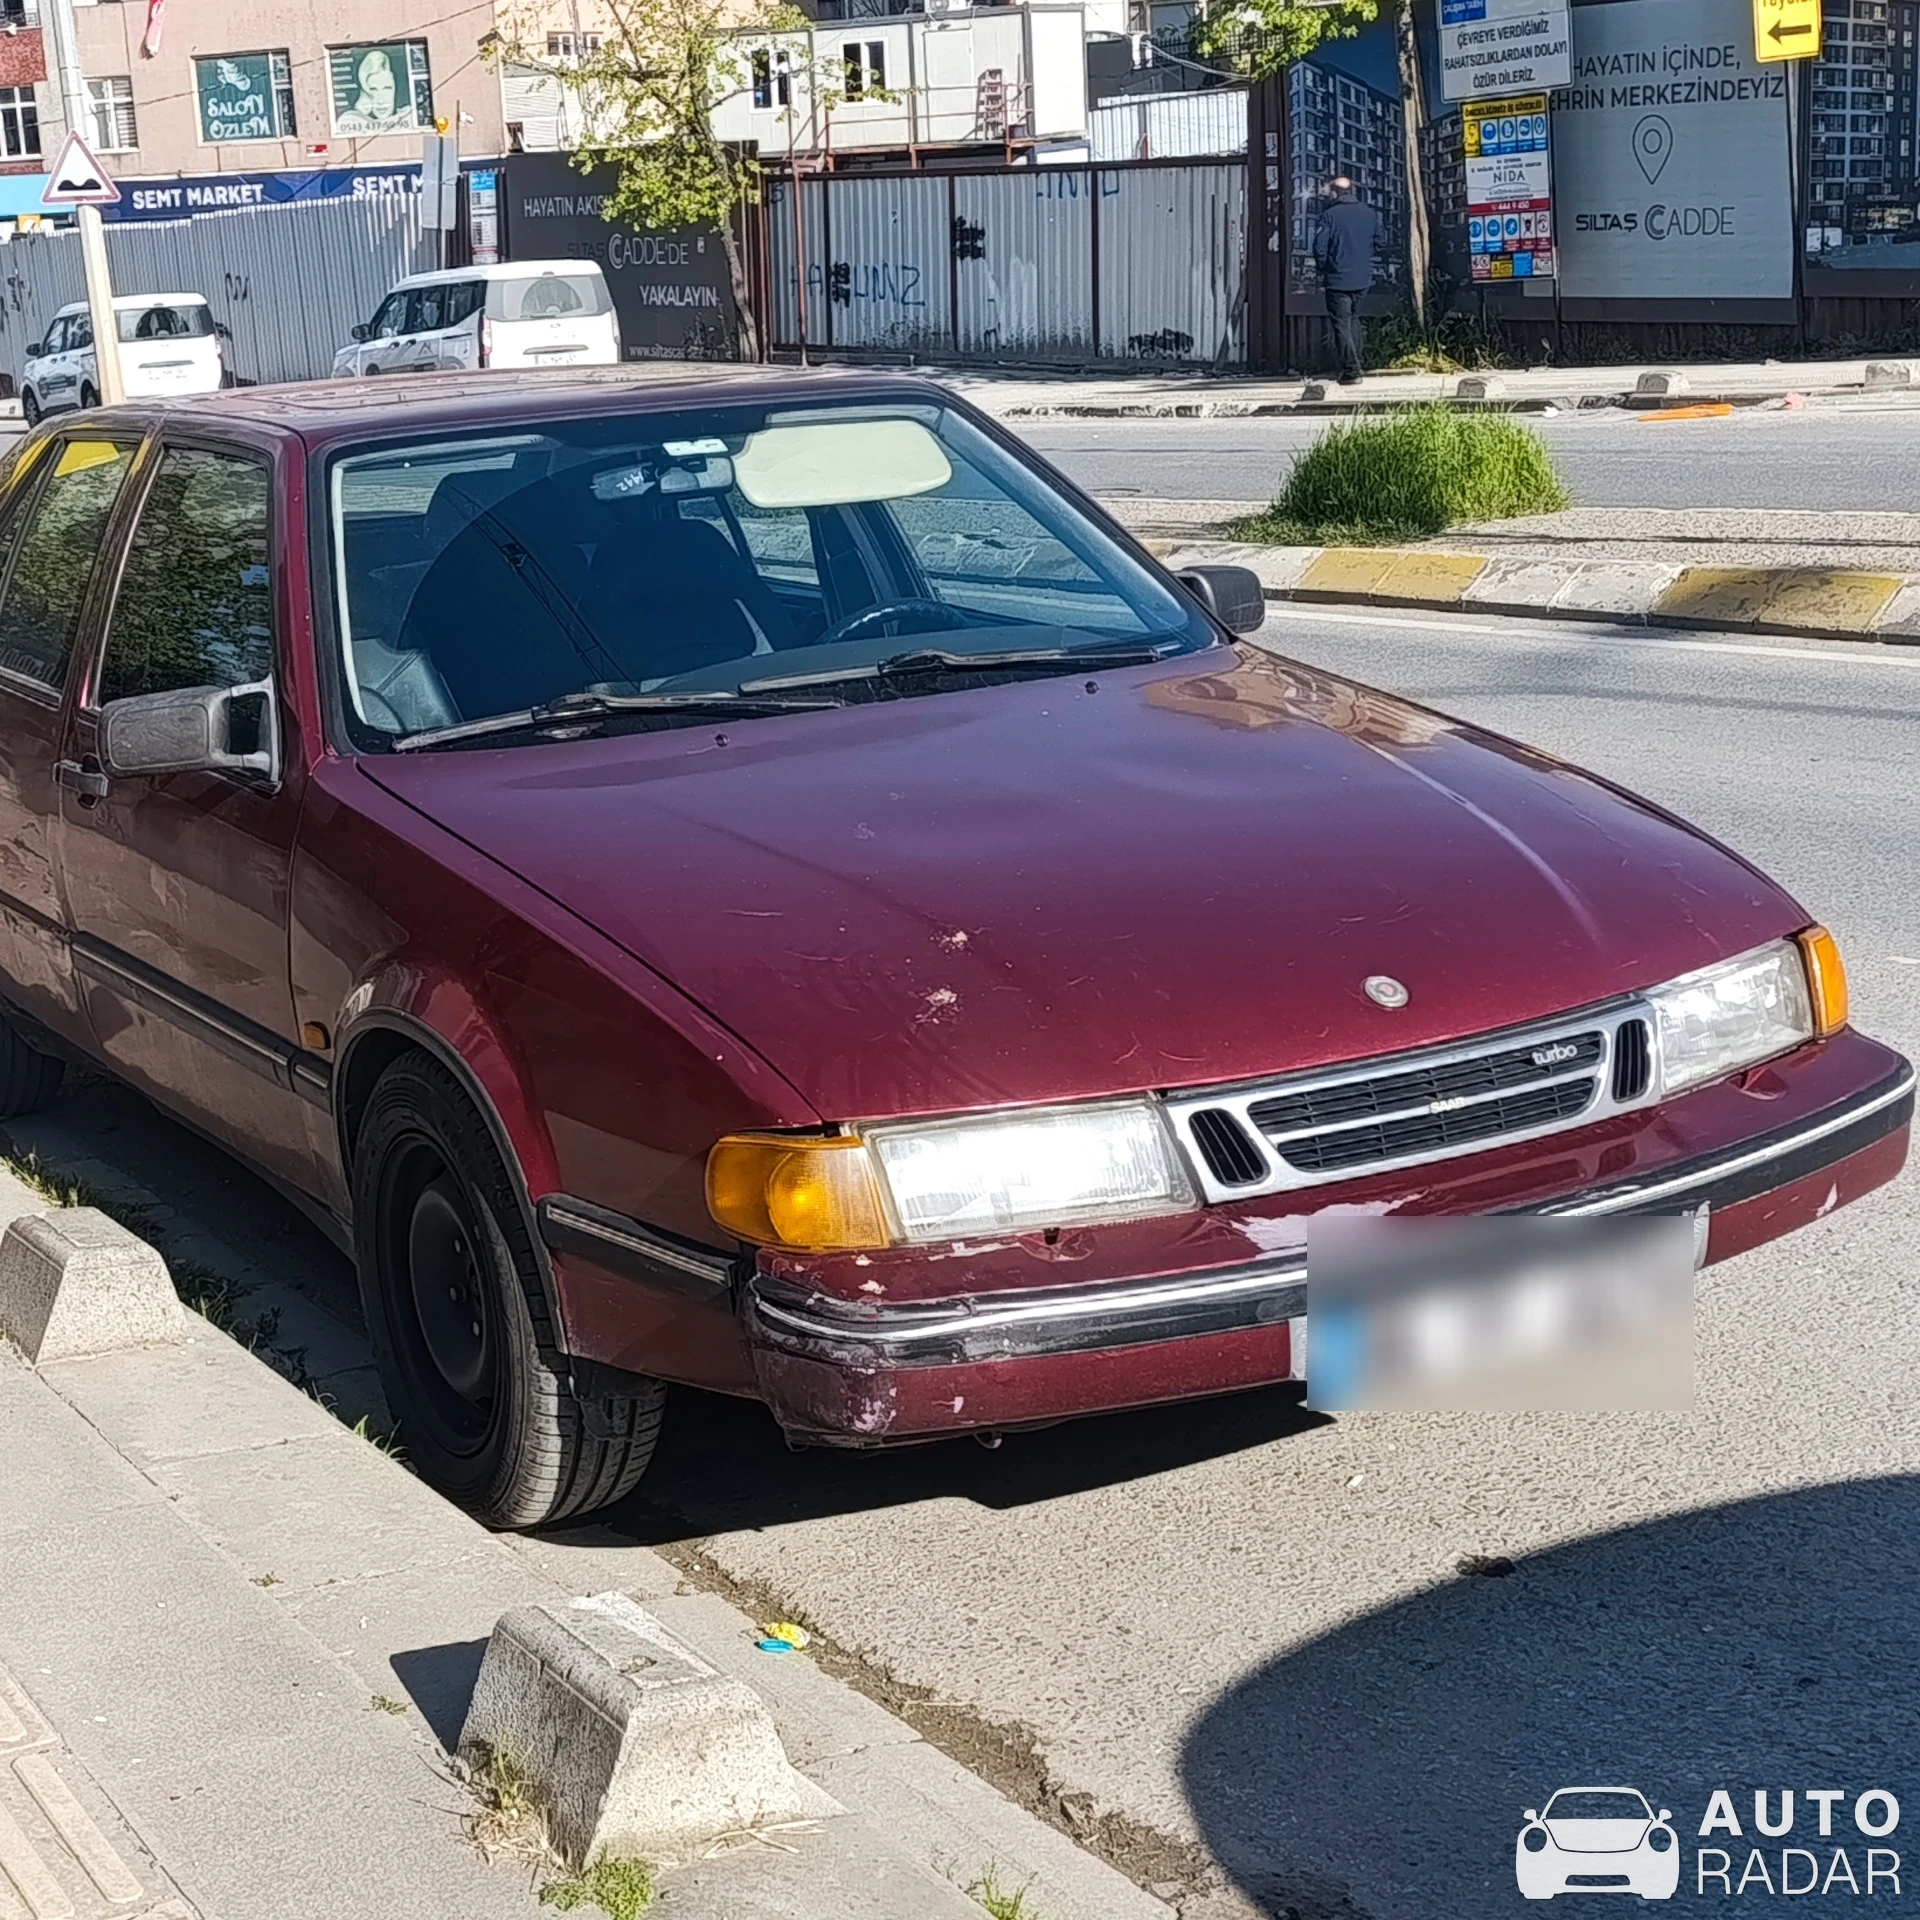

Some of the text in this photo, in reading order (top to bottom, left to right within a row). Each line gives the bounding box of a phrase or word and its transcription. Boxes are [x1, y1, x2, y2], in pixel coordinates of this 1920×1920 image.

[1457, 28, 1496, 50] ÇEVREYE
[1444, 41, 1568, 70] RAHATSIZLIKLARDAN DOLAYI
[1573, 44, 1741, 78] HAYATIN İÇİNDE,
[1473, 71, 1497, 88] ÖZÜR
[1611, 71, 1785, 108] MERKEZİNDEYİZ
[208, 94, 264, 117] SALON
[132, 183, 264, 210] SEMT MARKET
[352, 175, 406, 195] SEMT
[523, 196, 574, 218] HAYATIN
[1644, 203, 1736, 241] CADDE
[608, 233, 690, 269] CADDE'DE
[639, 285, 717, 307] YAKALAYIN
[1532, 1043, 1578, 1065] turbo
